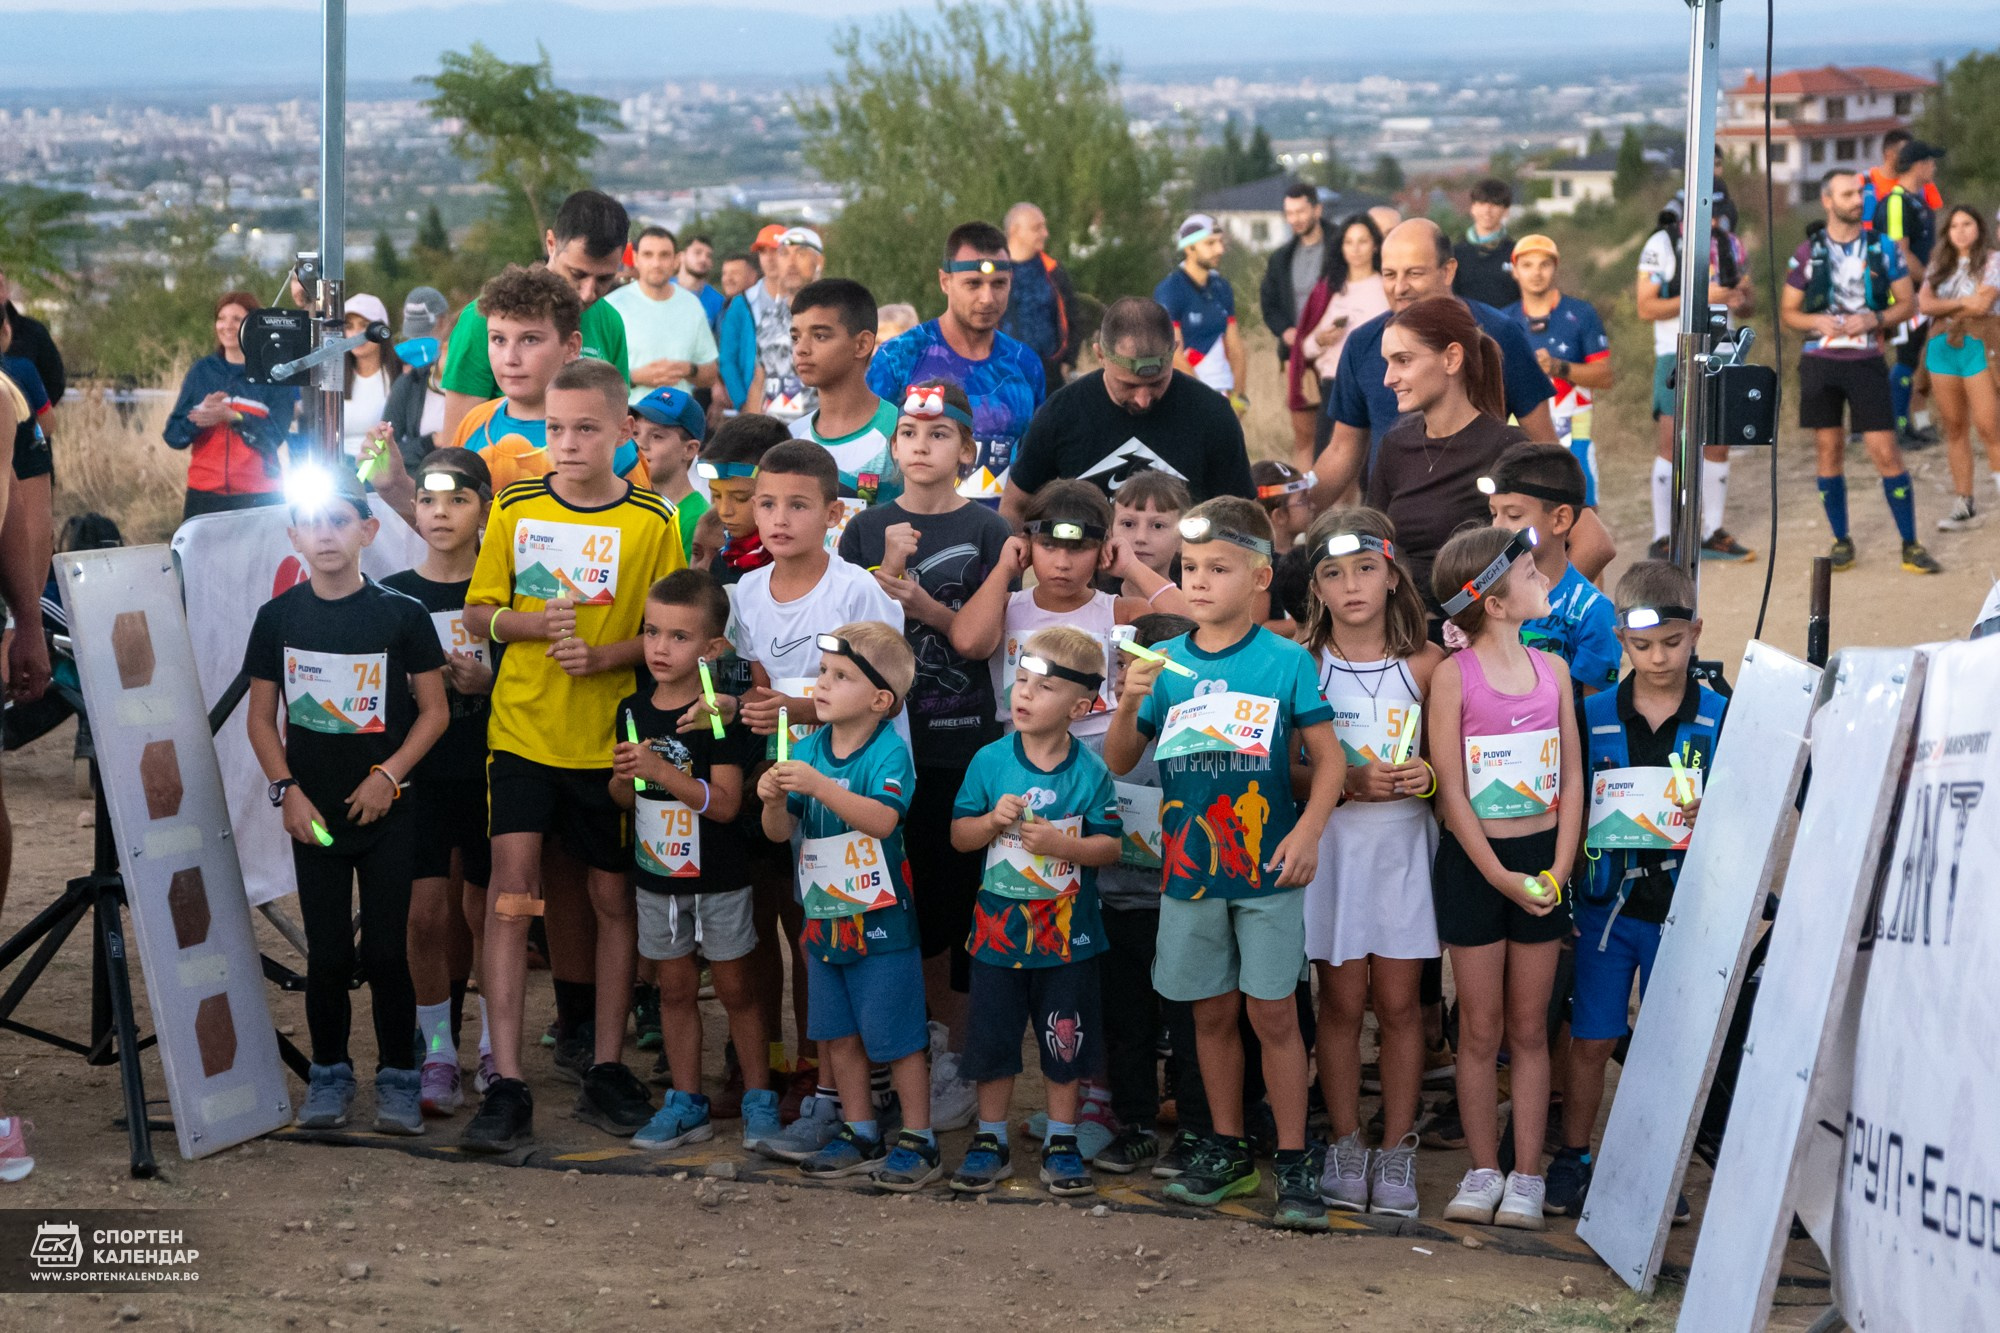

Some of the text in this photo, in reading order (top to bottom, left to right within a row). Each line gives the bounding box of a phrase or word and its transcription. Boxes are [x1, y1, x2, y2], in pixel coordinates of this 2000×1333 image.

[264, 318, 296, 326] VARYTEC
[529, 534, 555, 543] PLOVDIV
[581, 534, 614, 563] 42
[572, 567, 610, 584] KIDS
[298, 664, 322, 674] PLOVDIV
[353, 662, 381, 691] 74
[342, 696, 379, 712] KIDS
[1181, 704, 1208, 715] PLOVDIV
[1234, 699, 1271, 725] 82
[928, 716, 981, 730] MINECRAFT
[1223, 723, 1265, 739] KIDS
[1483, 750, 1512, 759] PLOVDIV
[1540, 737, 1559, 768] 47
[1534, 772, 1557, 792] KIDS
[1608, 782, 1635, 790] PLOVDIV
[661, 809, 693, 837] 79
[1656, 812, 1687, 827] KID
[656, 841, 691, 857] KIDS
[845, 838, 878, 869] 43
[1042, 861, 1075, 878] KIDS
[845, 871, 881, 893] KIDS
